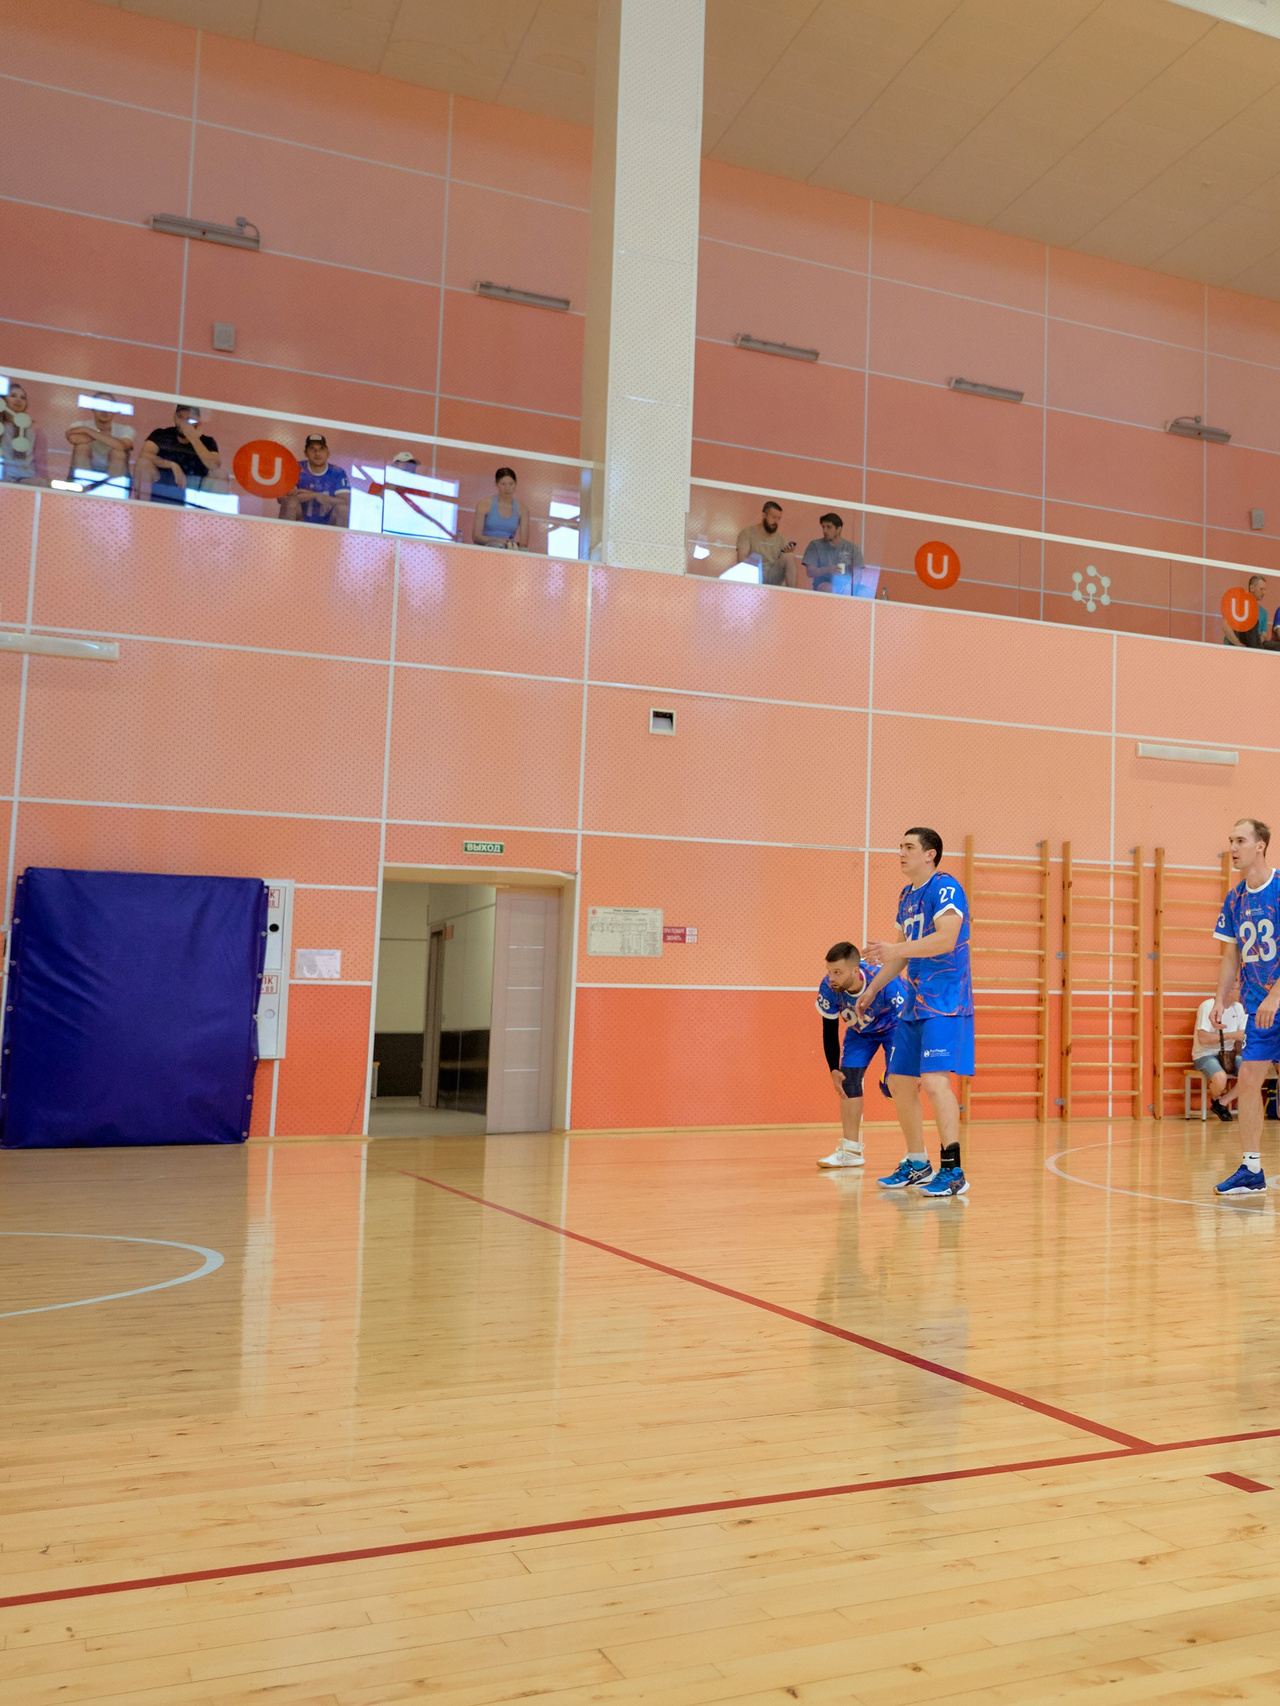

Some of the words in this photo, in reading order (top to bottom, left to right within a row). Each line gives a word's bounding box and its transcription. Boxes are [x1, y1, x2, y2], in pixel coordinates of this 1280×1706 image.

[251, 454, 283, 486] U
[926, 552, 949, 581] U
[1231, 598, 1249, 622] U
[467, 843, 501, 853] ВЫХОД
[938, 886, 956, 904] 27
[1239, 918, 1277, 963] 23
